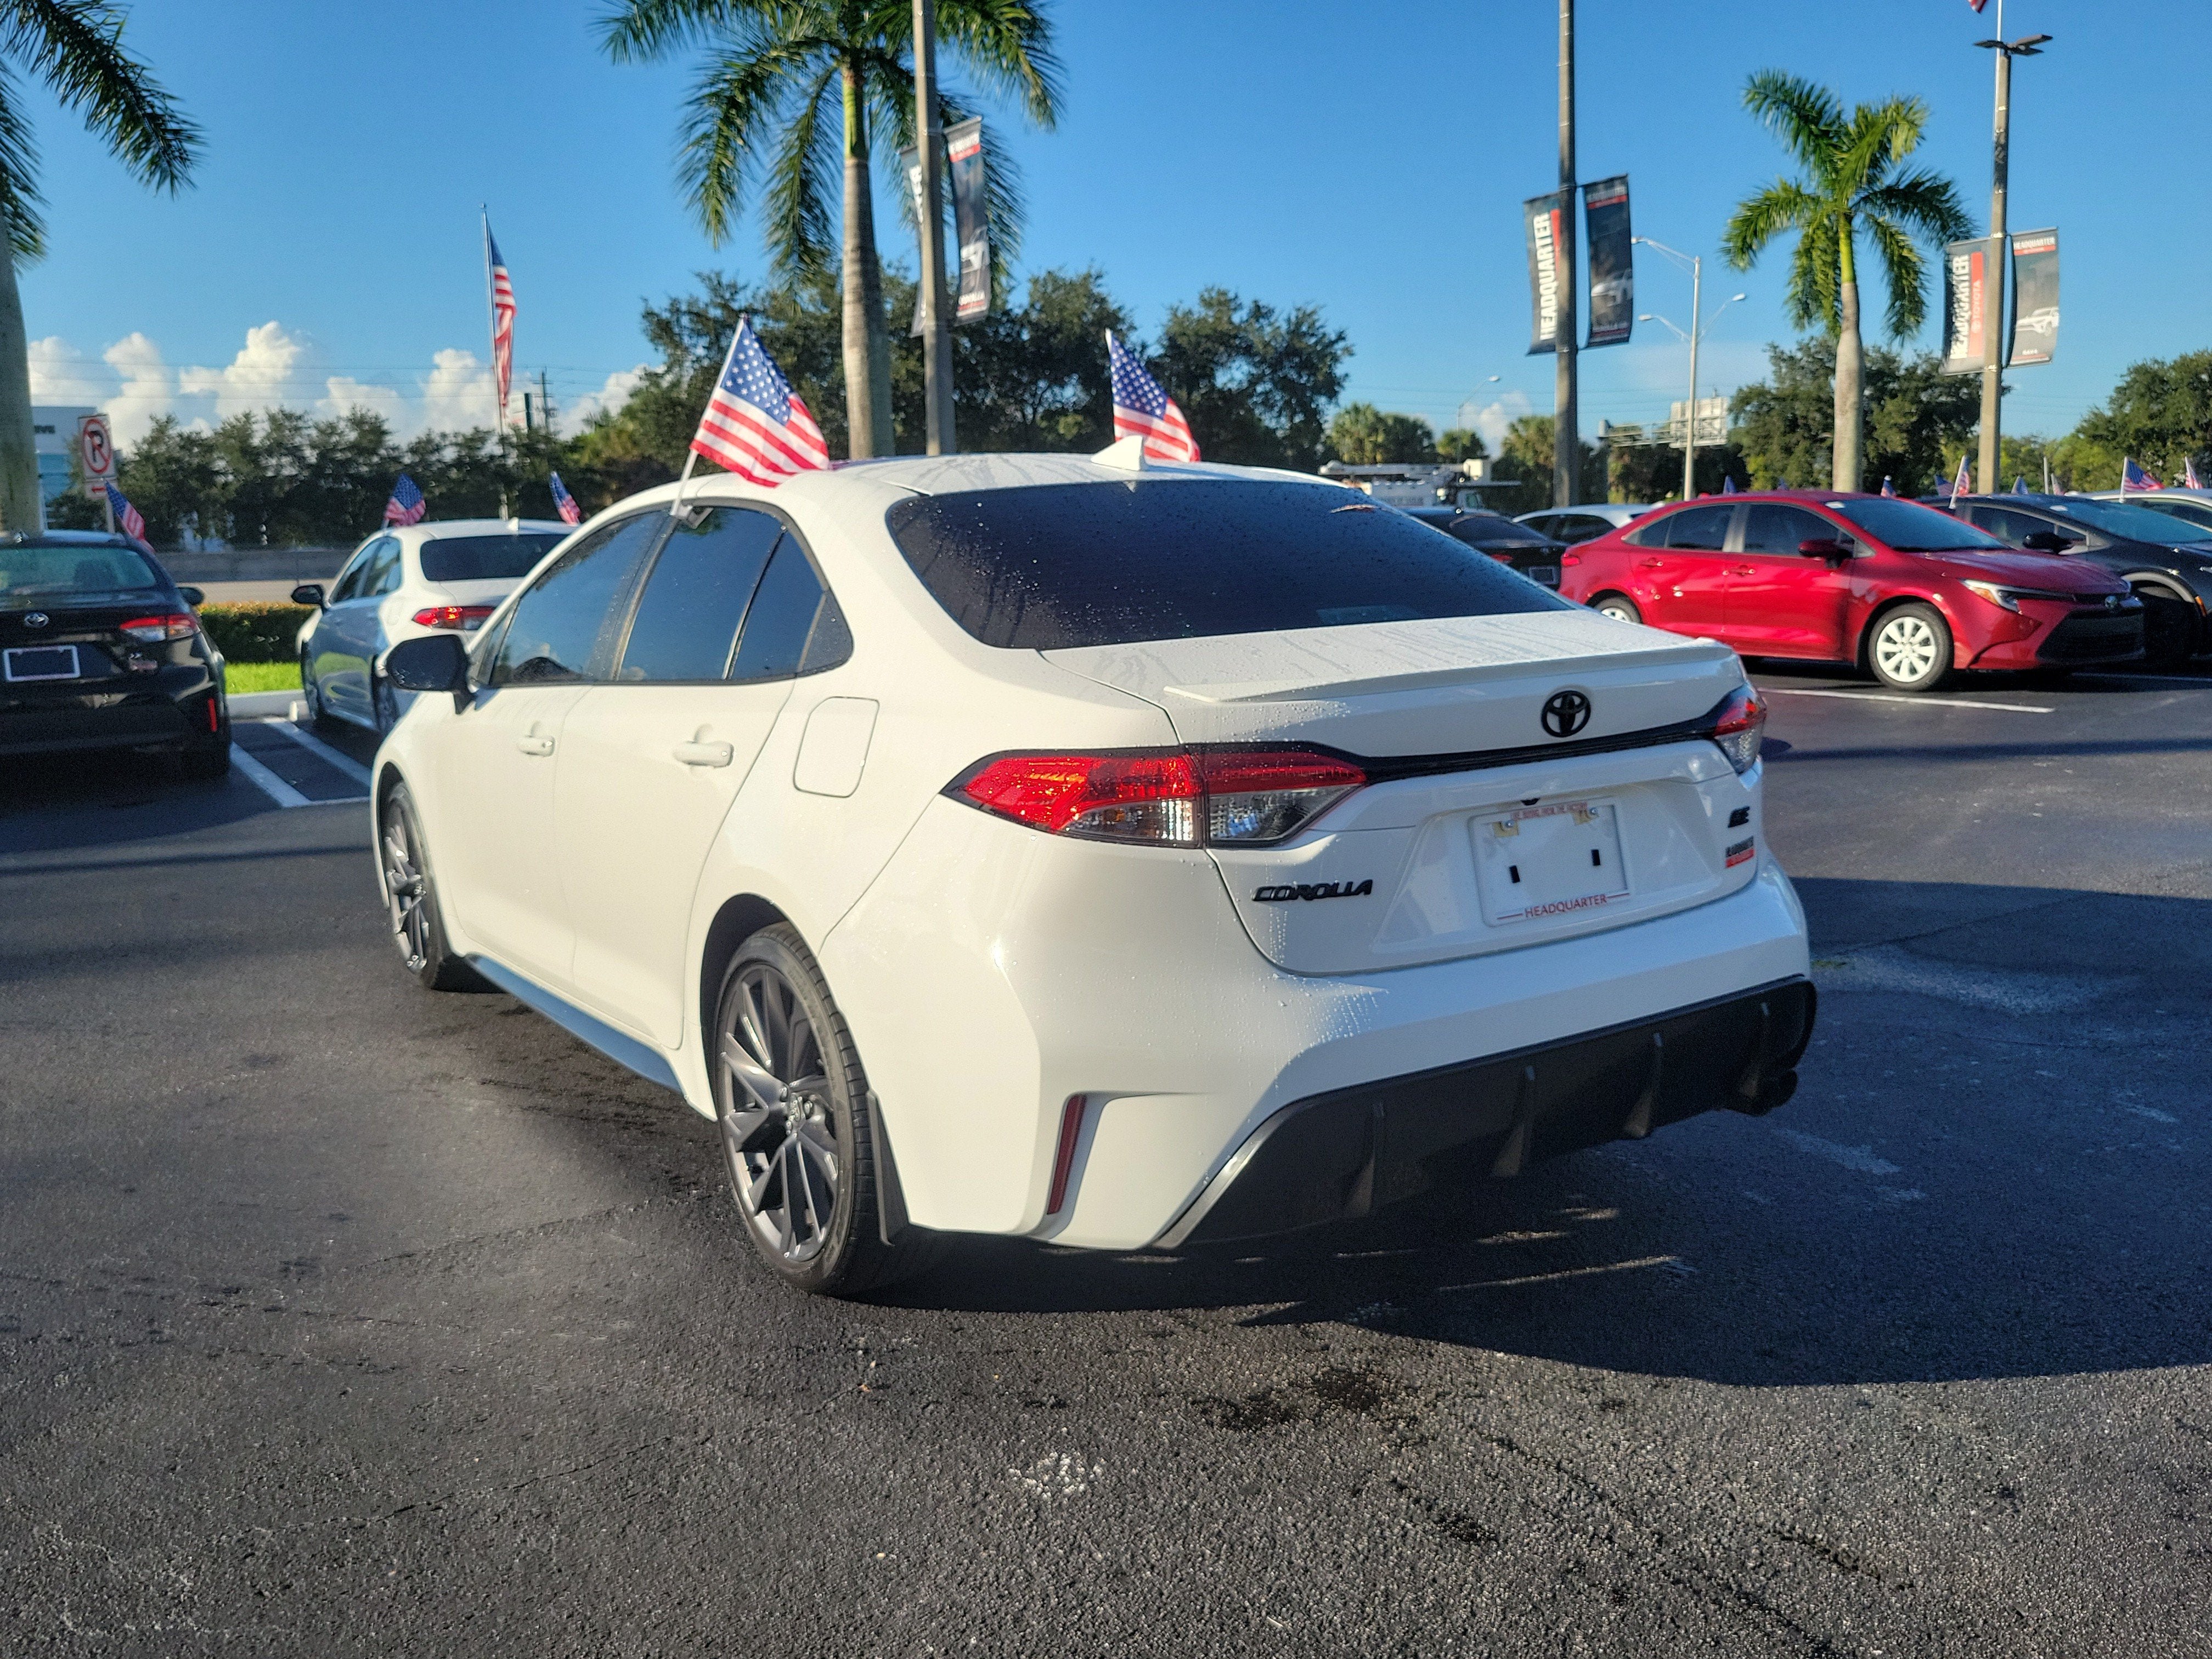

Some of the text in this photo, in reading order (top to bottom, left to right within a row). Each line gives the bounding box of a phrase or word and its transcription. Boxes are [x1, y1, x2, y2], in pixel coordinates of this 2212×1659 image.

[1533, 212, 1558, 340] HEADQUARTER
[1252, 879, 1373, 901] COROLLA
[1524, 894, 1607, 918] HEADQUARTER
